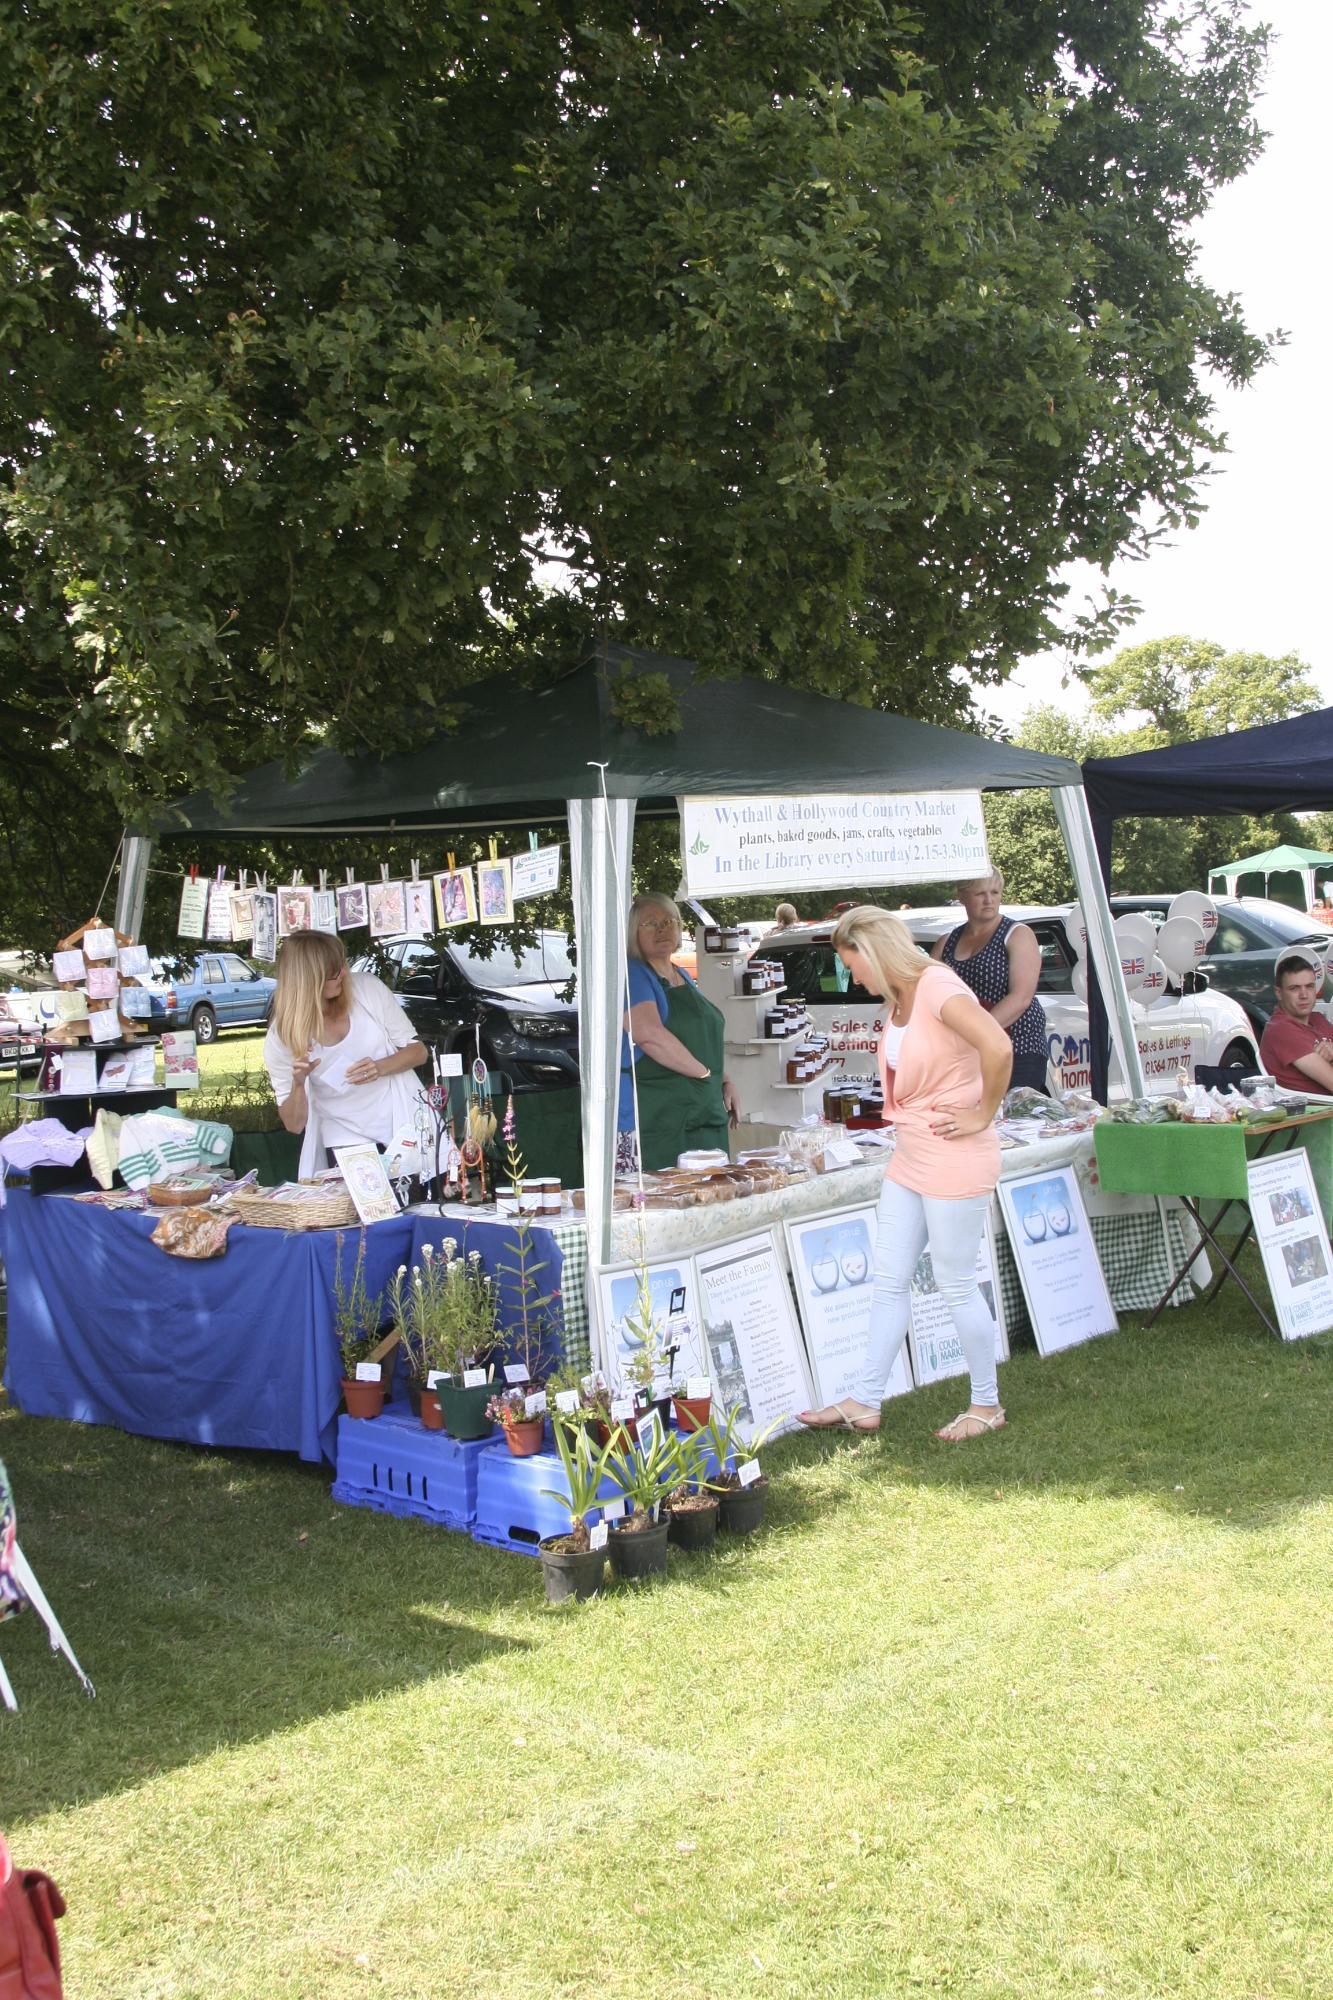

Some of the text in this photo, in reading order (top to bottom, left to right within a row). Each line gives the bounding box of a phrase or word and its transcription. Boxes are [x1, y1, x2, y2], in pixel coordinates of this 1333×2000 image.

[715, 800, 956, 828] Wythall & Hollywood Country Market
[740, 832, 775, 849] plants,
[777, 829, 804, 843] baked
[807, 827, 840, 844] goods,
[898, 824, 942, 838] vegetables
[715, 855, 732, 873] In
[738, 854, 760, 871] the
[766, 852, 813, 871] Library
[818, 851, 853, 868] every
[856, 845, 910, 864] Saturday
[831, 1019, 884, 1033] Sales &
[1158, 1037, 1164, 1051] &
[1166, 1034, 1191, 1050] Lettings
[1168, 1056, 1179, 1070] 779
[705, 1274, 728, 1290] Meet
[729, 1269, 742, 1282] the
[743, 1259, 772, 1276] Family
[940, 1337, 960, 1351] COUN
[941, 1346, 966, 1360] MARKE
